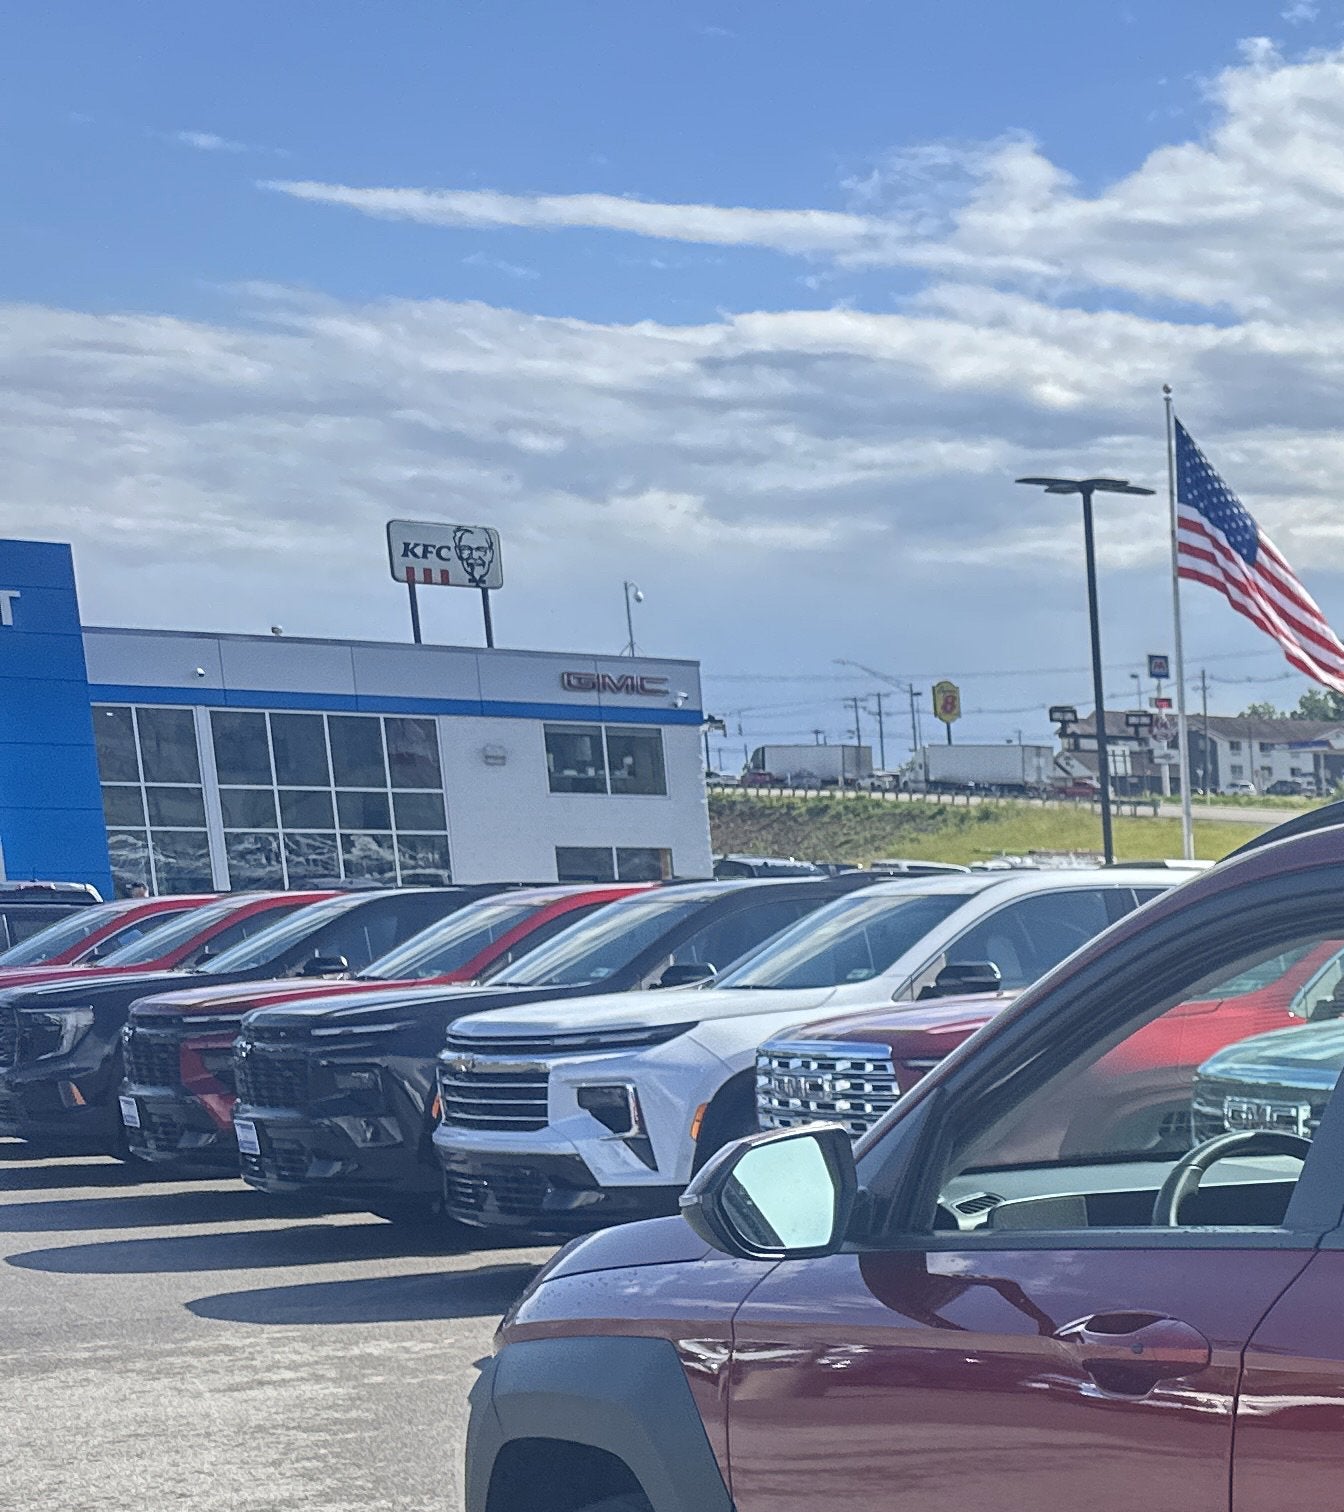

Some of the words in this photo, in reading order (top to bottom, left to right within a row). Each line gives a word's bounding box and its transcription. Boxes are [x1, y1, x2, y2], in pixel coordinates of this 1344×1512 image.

[401, 541, 452, 562] KFC
[561, 671, 670, 697] GMC
[1225, 1098, 1301, 1136] GMC
